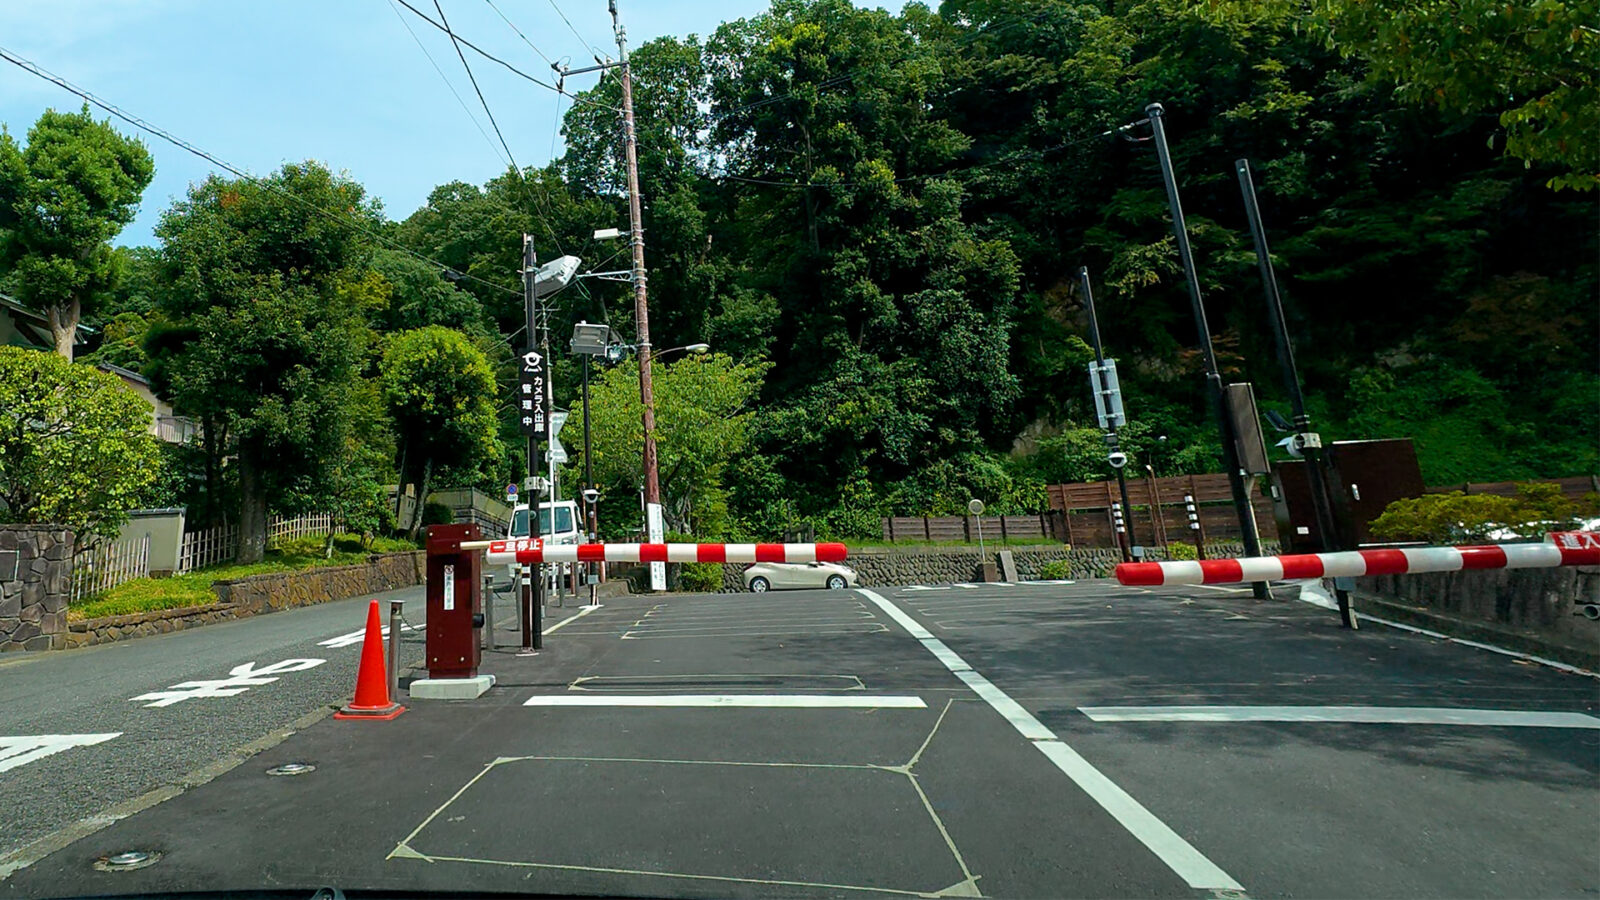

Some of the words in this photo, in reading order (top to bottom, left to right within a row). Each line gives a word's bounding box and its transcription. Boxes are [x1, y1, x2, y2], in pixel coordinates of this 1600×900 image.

[521, 383, 532, 426] 管理中
[534, 376, 545, 432] カメラ入出庫
[493, 539, 541, 552] 一旦停止
